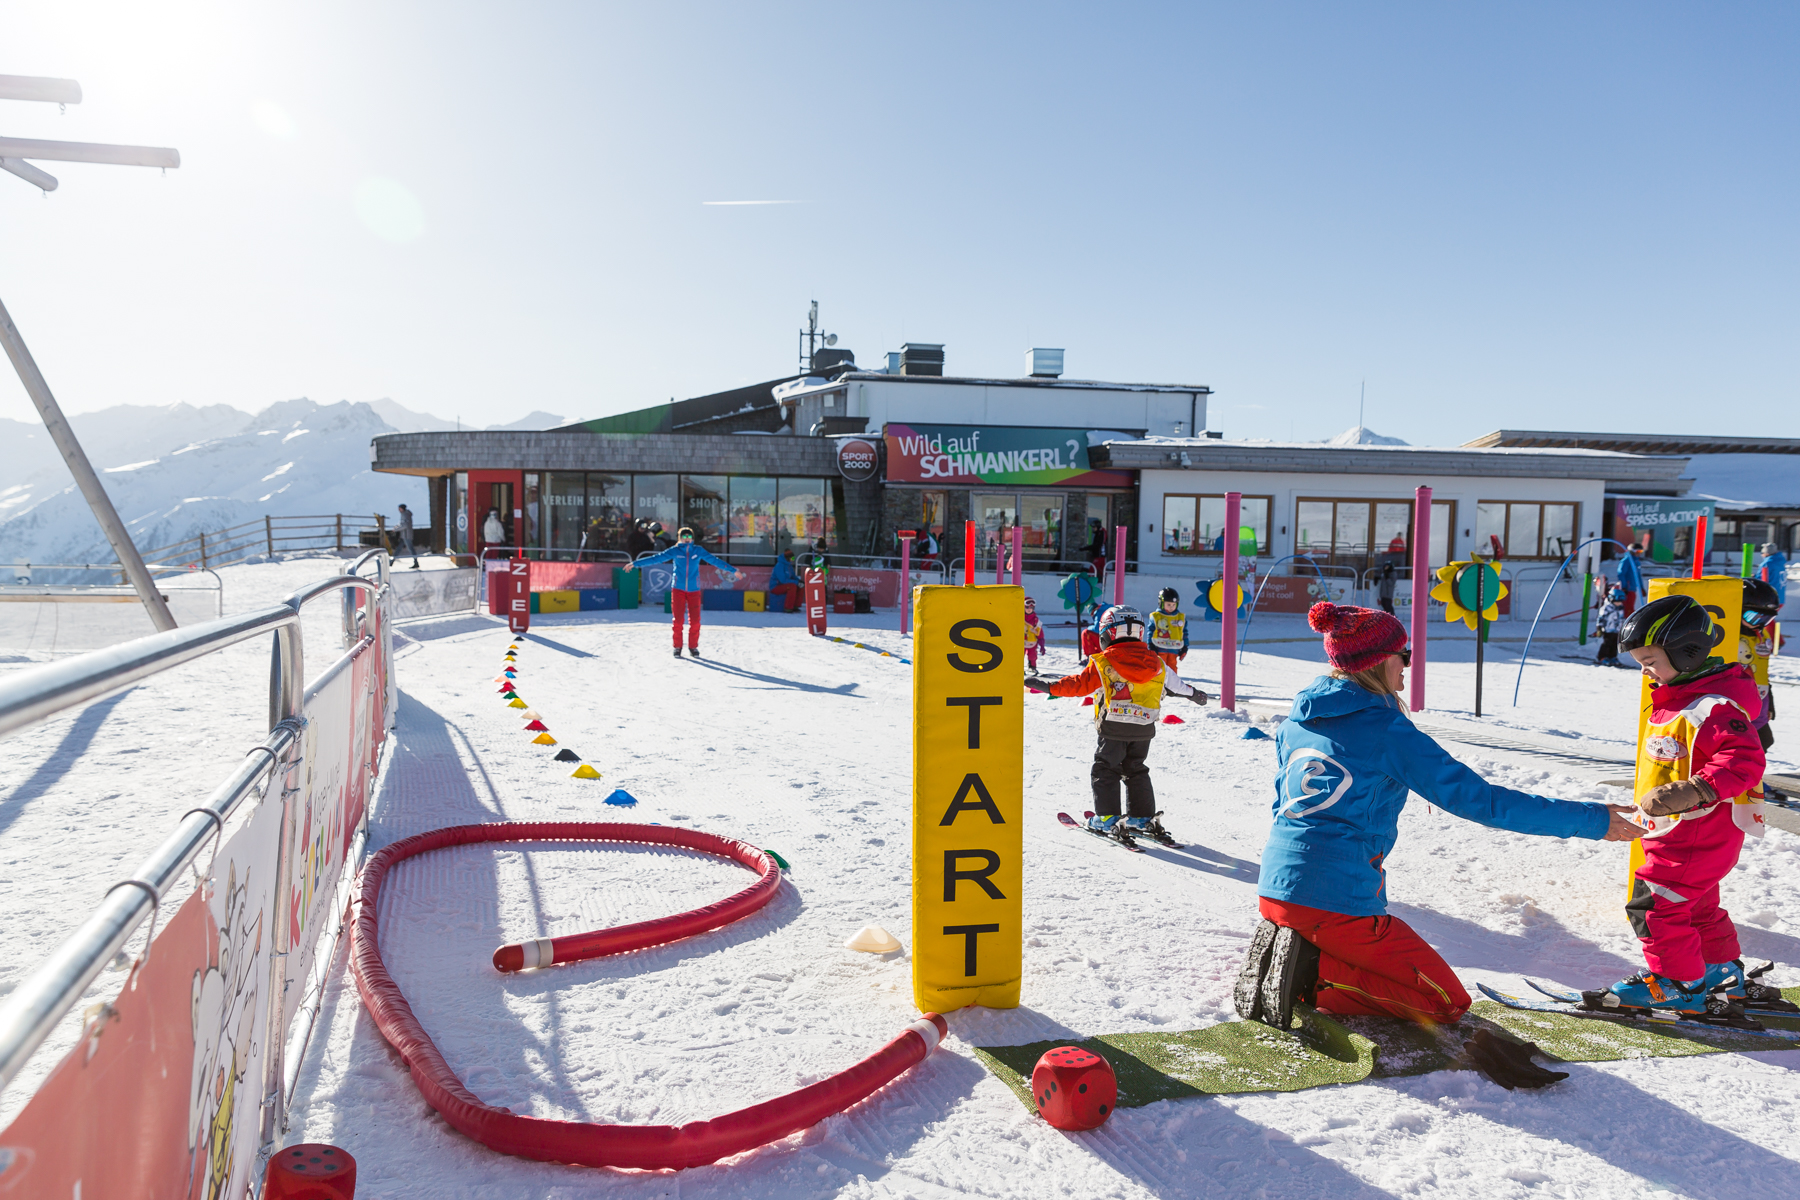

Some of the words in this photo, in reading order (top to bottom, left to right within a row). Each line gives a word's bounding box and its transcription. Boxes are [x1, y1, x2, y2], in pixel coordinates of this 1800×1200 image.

[899, 433, 942, 456] Wild
[947, 431, 980, 454] auf
[842, 452, 874, 461] SPORT
[844, 461, 871, 469] 2000
[542, 495, 584, 506] VERLEIH
[589, 496, 630, 507] SERVICE
[689, 498, 718, 508] SHOP
[1622, 503, 1643, 515] Wild
[1644, 501, 1660, 513] auf
[1626, 513, 1658, 527] SPASS
[859, 575, 882, 587] Kogel-
[512, 563, 527, 629] ZIEL
[809, 572, 824, 635] ZIEL
[938, 618, 1007, 977] START
